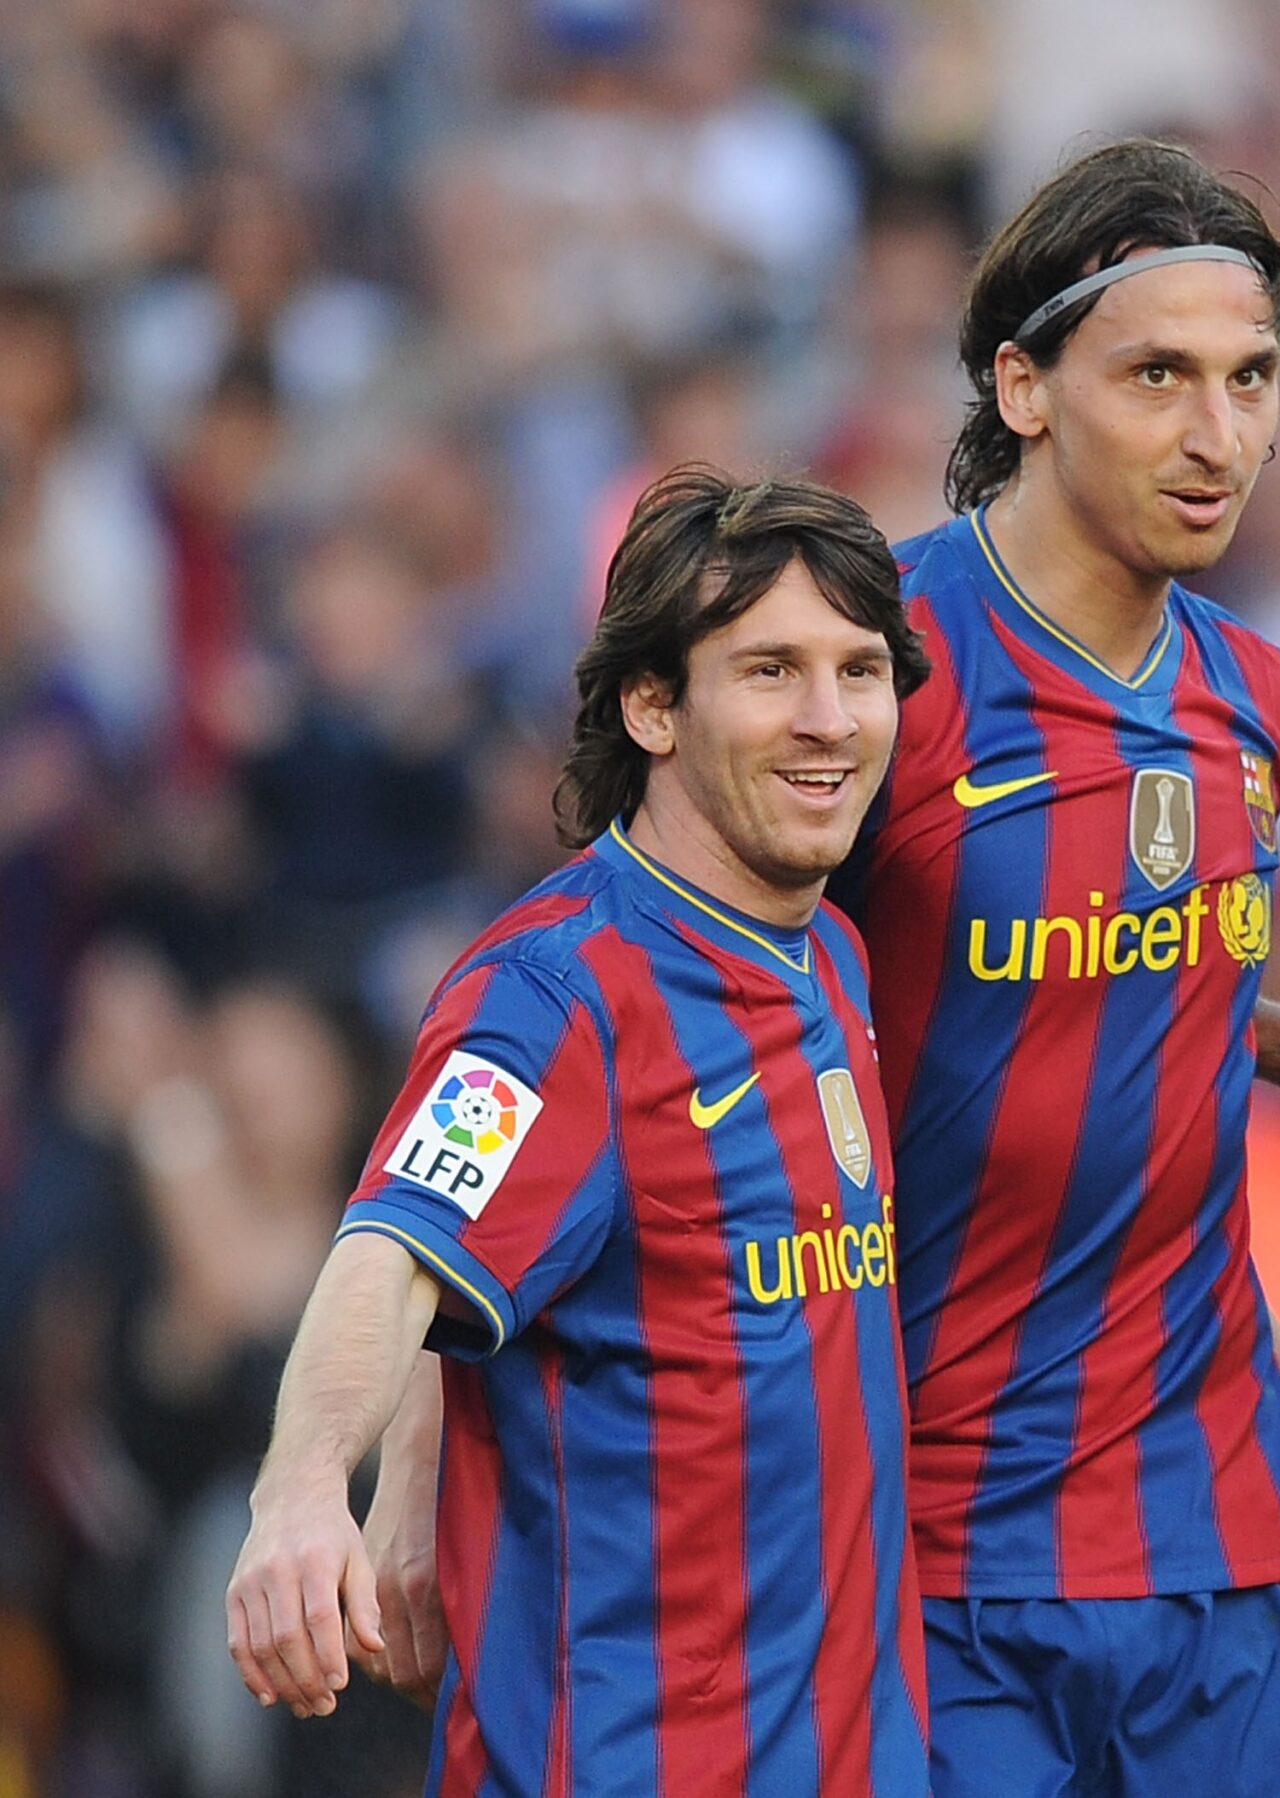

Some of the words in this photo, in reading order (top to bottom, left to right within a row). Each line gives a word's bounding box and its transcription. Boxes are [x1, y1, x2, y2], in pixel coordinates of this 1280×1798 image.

[968, 883, 1210, 981] unicef
[400, 1139, 484, 1194] LFP
[746, 1194, 895, 1304] unicef
